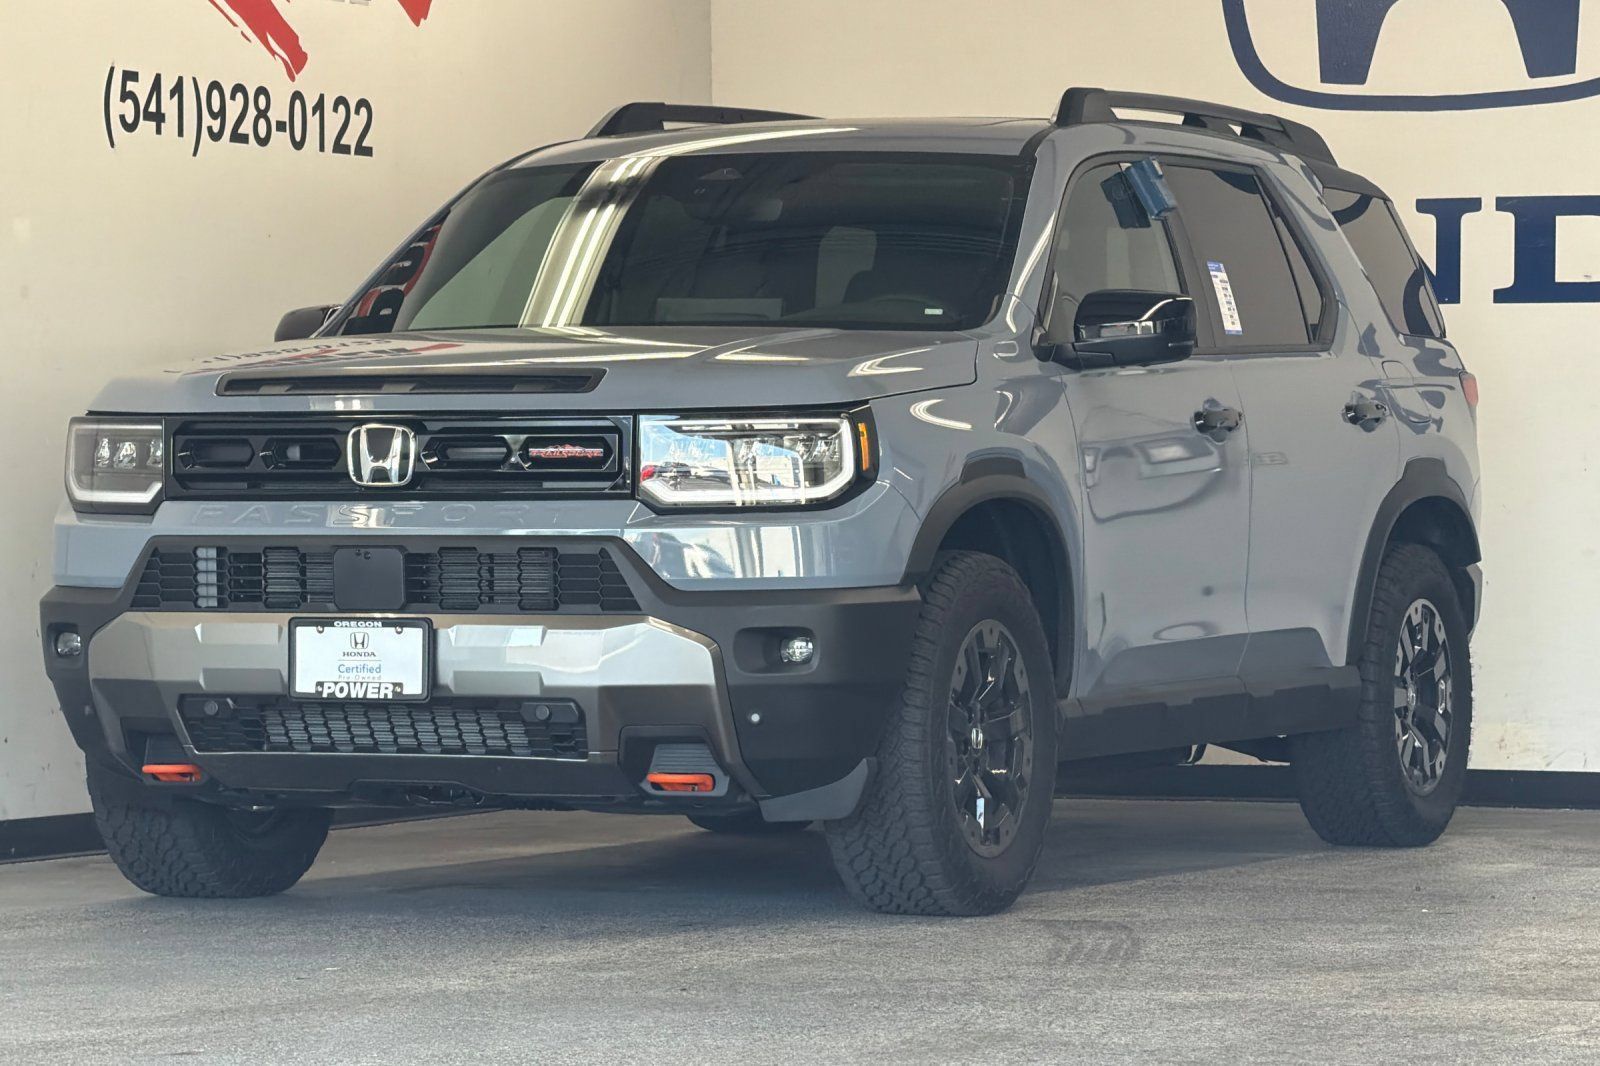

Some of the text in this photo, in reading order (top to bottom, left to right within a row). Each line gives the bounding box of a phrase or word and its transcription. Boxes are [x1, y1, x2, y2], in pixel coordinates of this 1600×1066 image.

[103, 65, 374, 158] (541)928-0122
[333, 620, 382, 628] OREGON
[337, 663, 382, 674] Certified
[321, 681, 394, 699] POWER
